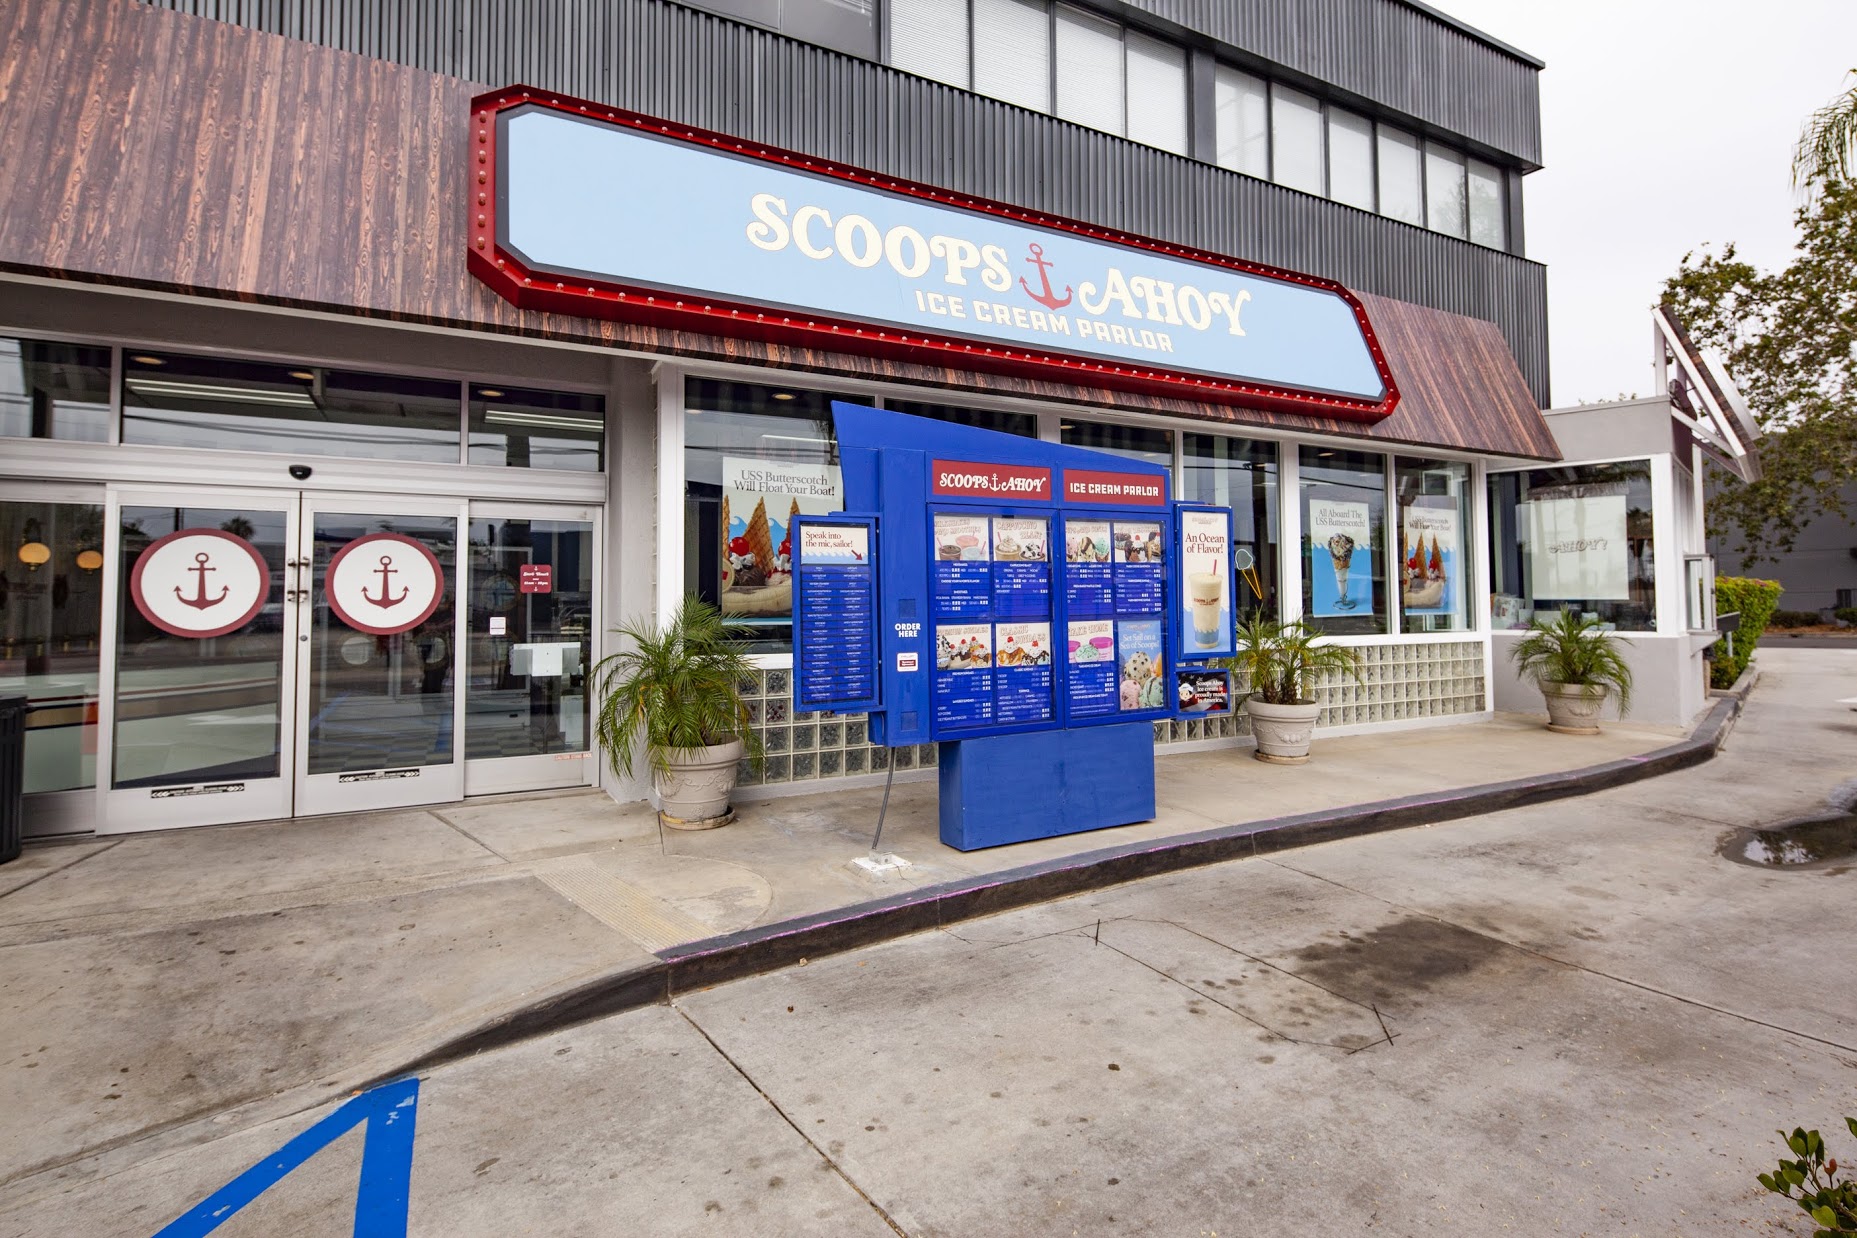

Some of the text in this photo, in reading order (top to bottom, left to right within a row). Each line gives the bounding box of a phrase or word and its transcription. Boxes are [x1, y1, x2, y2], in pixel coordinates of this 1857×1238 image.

[746, 193, 1252, 337] SCOOPS AHOY
[915, 289, 1174, 353] ICE CREAM PARLOR
[741, 469, 828, 486] USS Butterscotch
[939, 473, 1047, 492] SCOOPS AHOY
[734, 479, 835, 496] Will Float Your Boat!
[1070, 482, 1159, 497] ICE CREAM PARLOR
[1318, 508, 1362, 518] All Aboard The
[1315, 517, 1328, 526] USS
[806, 531, 842, 540] Speak into
[1185, 532, 1225, 544] An Ocean
[806, 540, 853, 548] the mic, sailor!
[1186, 543, 1224, 554] of Flavor!
[894, 623, 921, 631] ORDER
